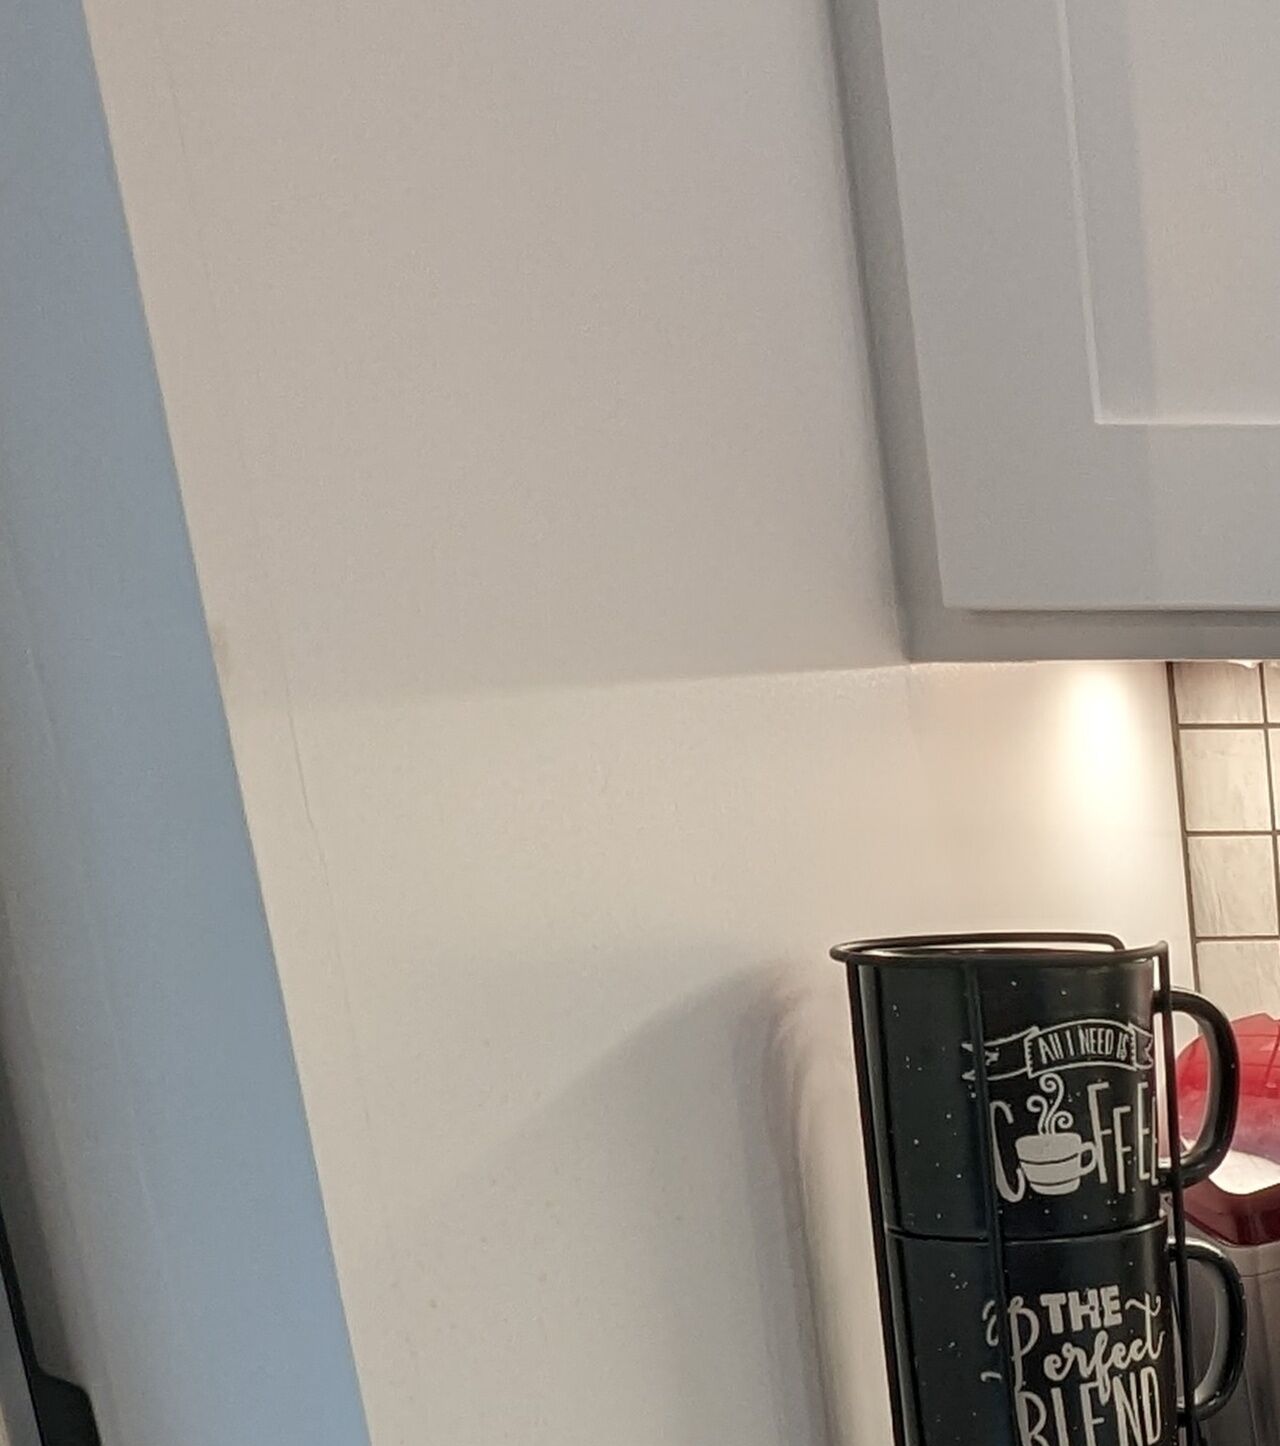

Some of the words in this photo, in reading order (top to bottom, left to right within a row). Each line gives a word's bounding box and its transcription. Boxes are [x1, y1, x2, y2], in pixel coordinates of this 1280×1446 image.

[1065, 1029, 1075, 1057] I
[1078, 1025, 1114, 1056] NEED
[1116, 1031, 1129, 1061] IS
[1040, 1285, 1123, 1334] THE
[981, 1293, 1166, 1406] Perfect
